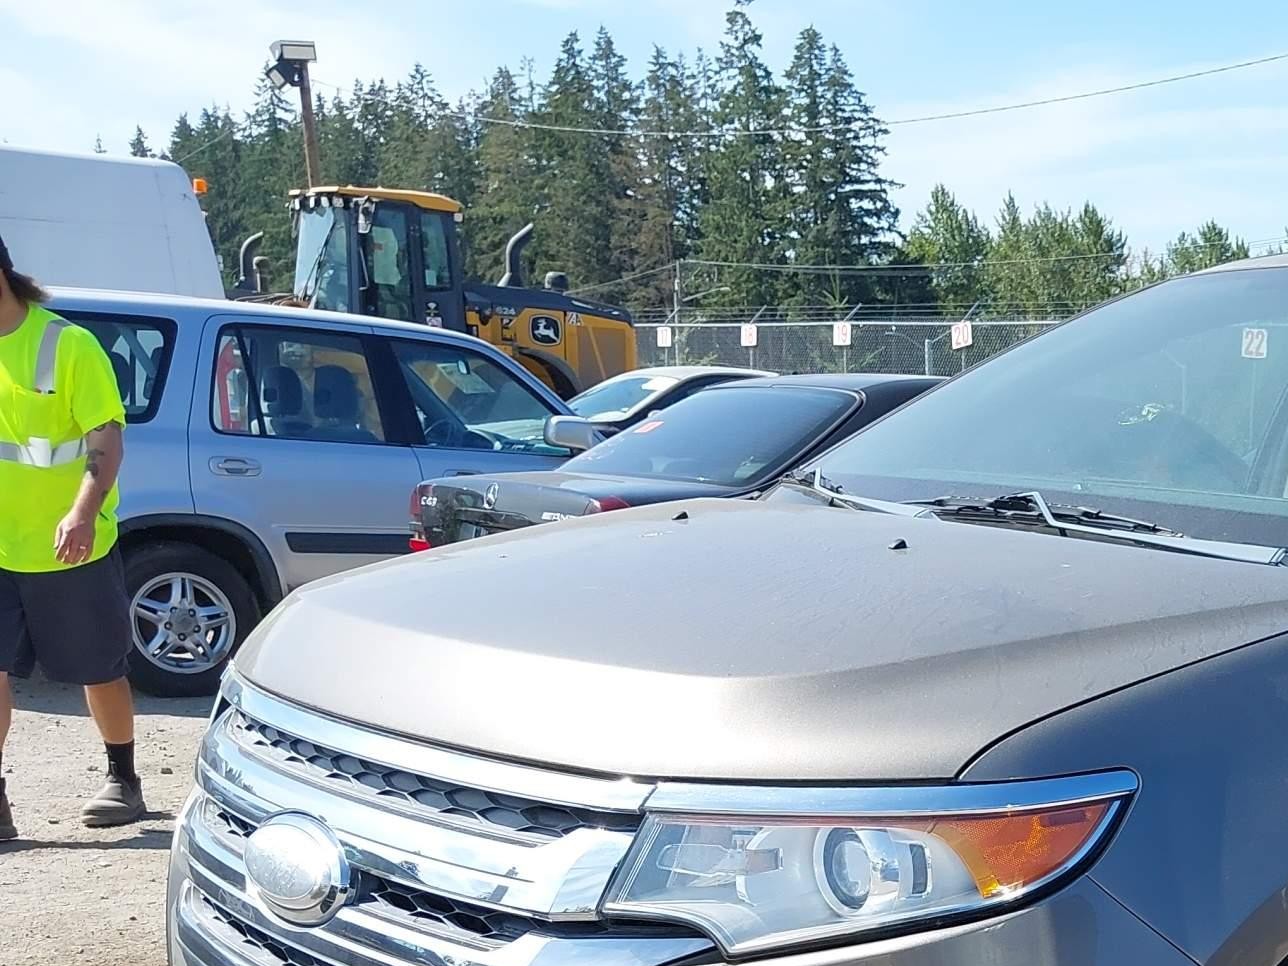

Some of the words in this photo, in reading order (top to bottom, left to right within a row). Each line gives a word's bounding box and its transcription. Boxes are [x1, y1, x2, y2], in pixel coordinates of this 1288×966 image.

[837, 324, 848, 344] 19
[954, 324, 969, 347] 20
[1245, 330, 1265, 357] 22
